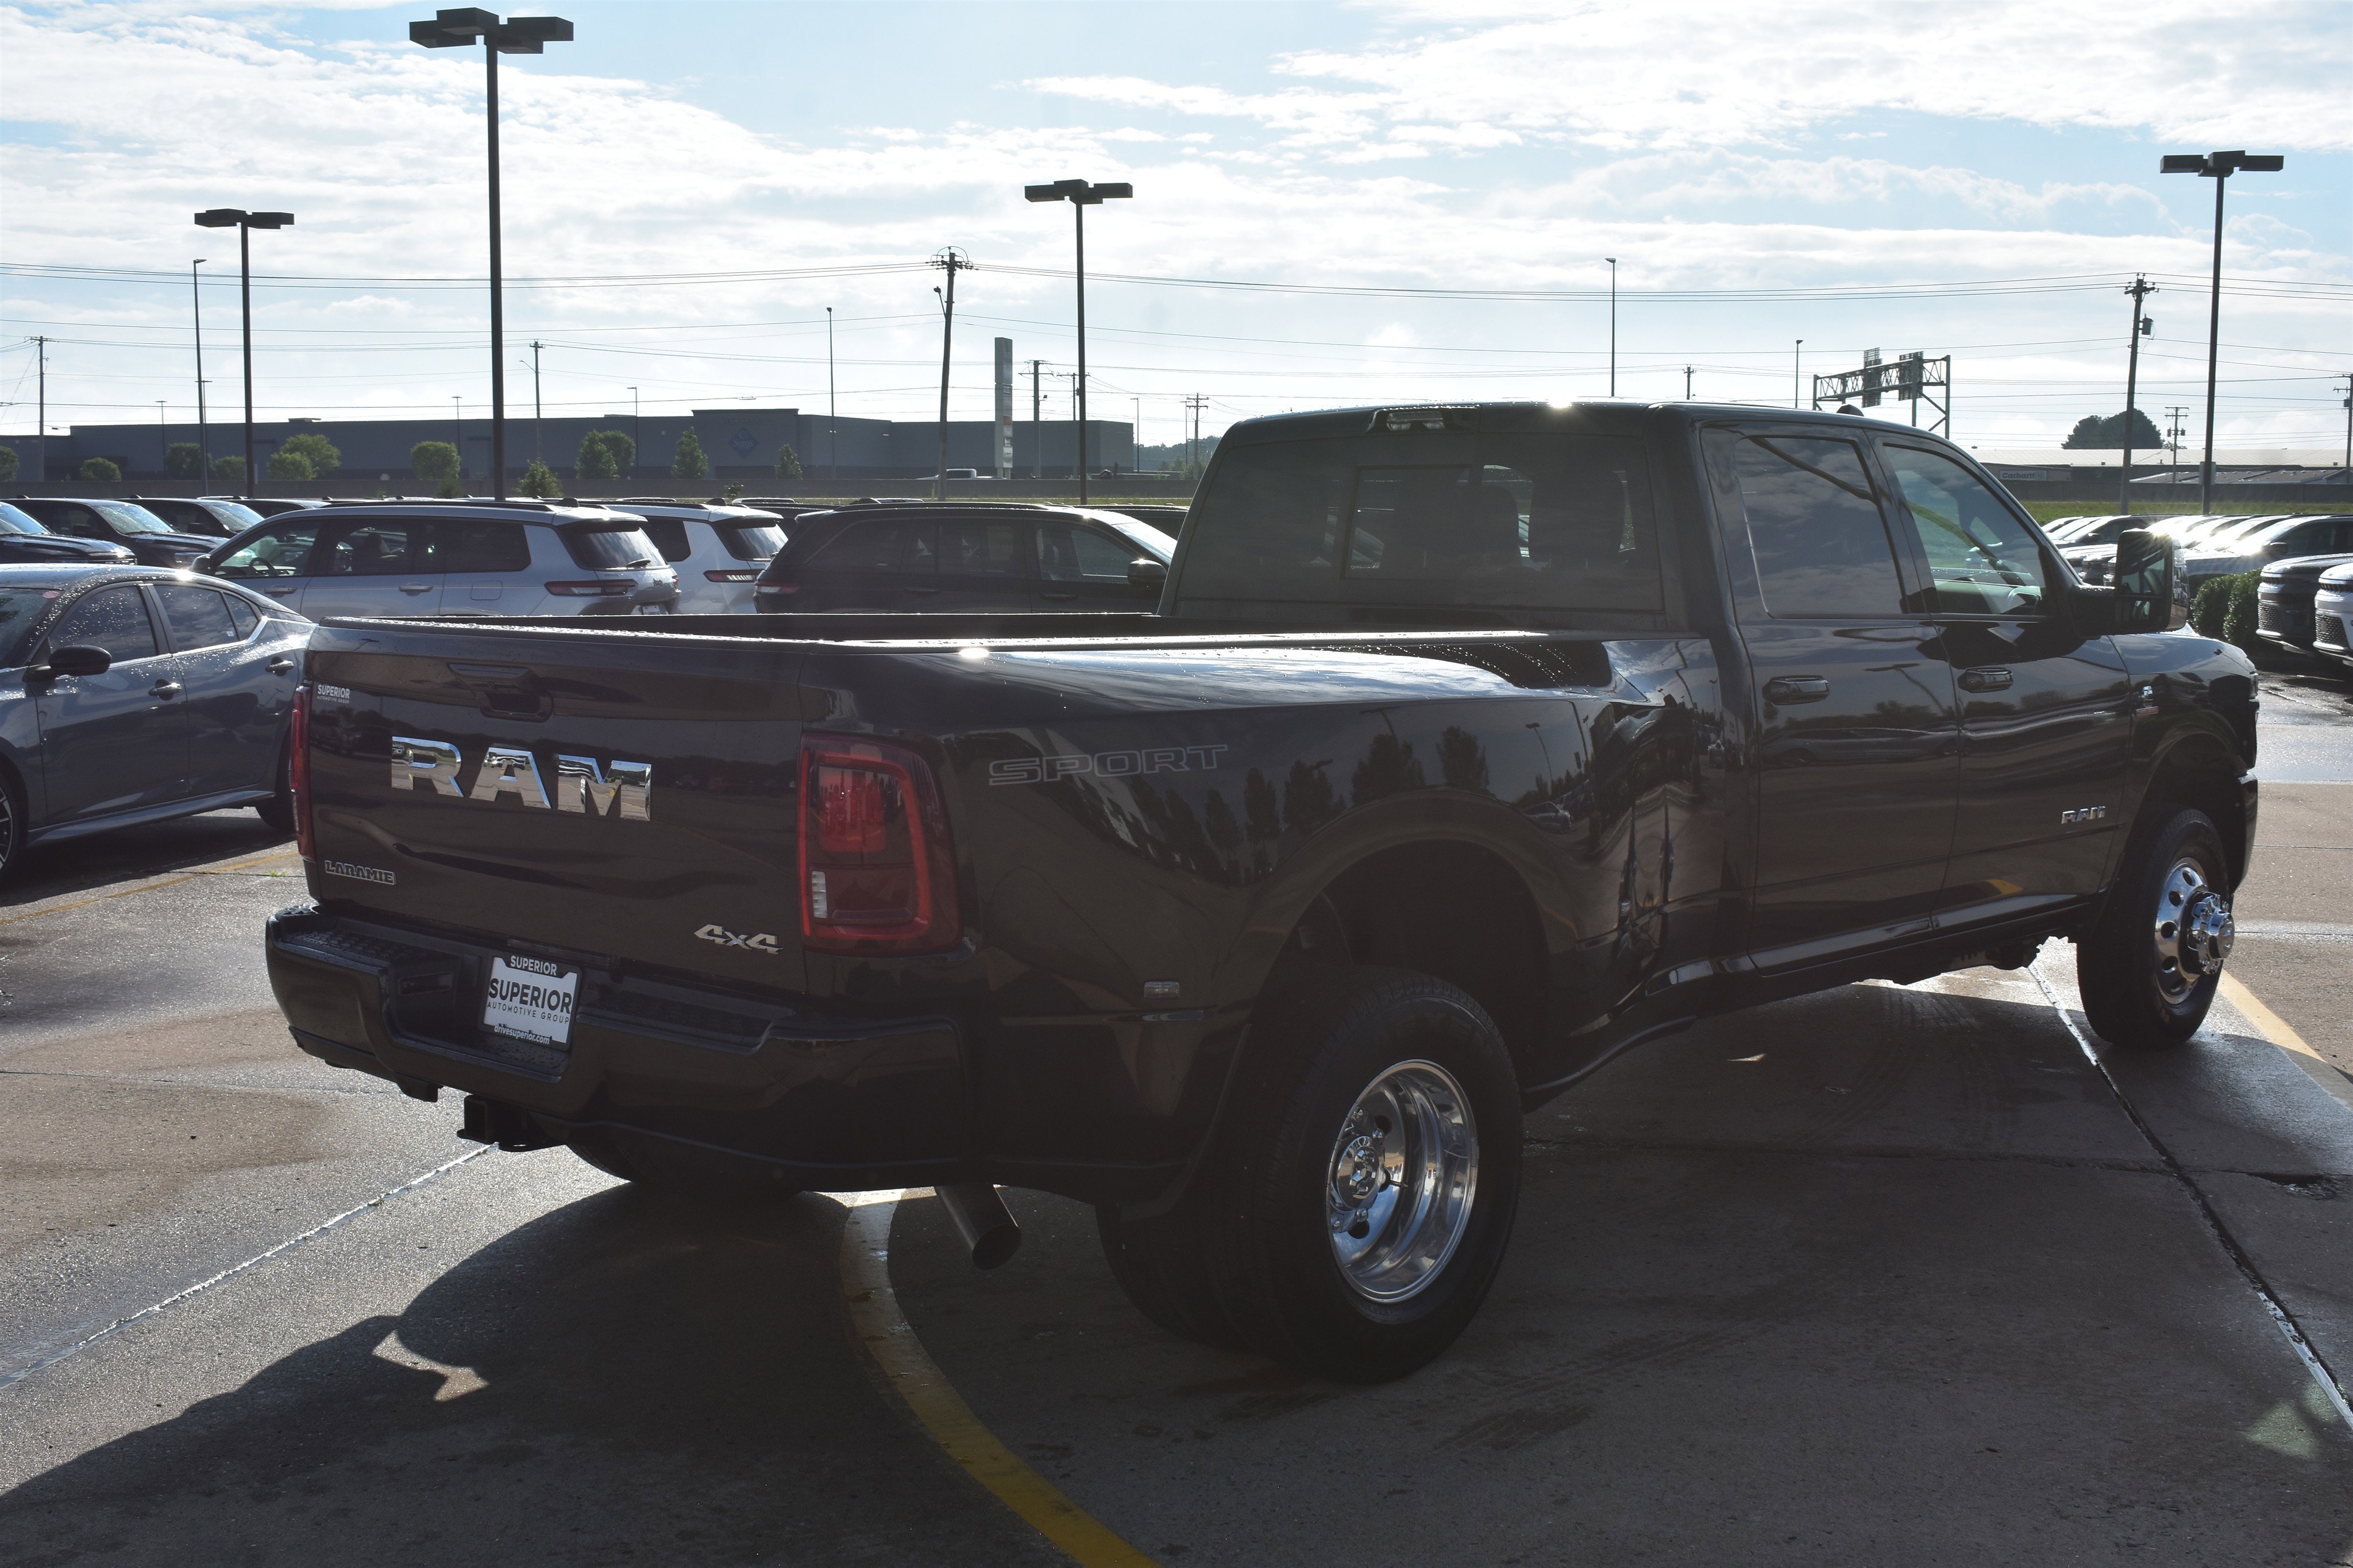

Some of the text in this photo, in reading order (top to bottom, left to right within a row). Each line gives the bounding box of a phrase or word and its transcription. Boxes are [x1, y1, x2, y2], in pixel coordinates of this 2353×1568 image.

[318, 684, 350, 699] SUPERIOR
[989, 744, 1228, 786] SPORT
[391, 736, 651, 821] RAM
[2061, 806, 2106, 824] RAM
[325, 860, 395, 885] LARAMIE
[694, 924, 784, 955] 4x4
[510, 955, 557, 976] SUPERIOR
[488, 978, 572, 1014] SUPERIOR
[487, 1001, 569, 1024] AUTOMOTIVE GROUP
[494, 1025, 550, 1045] drivesuperior.com
